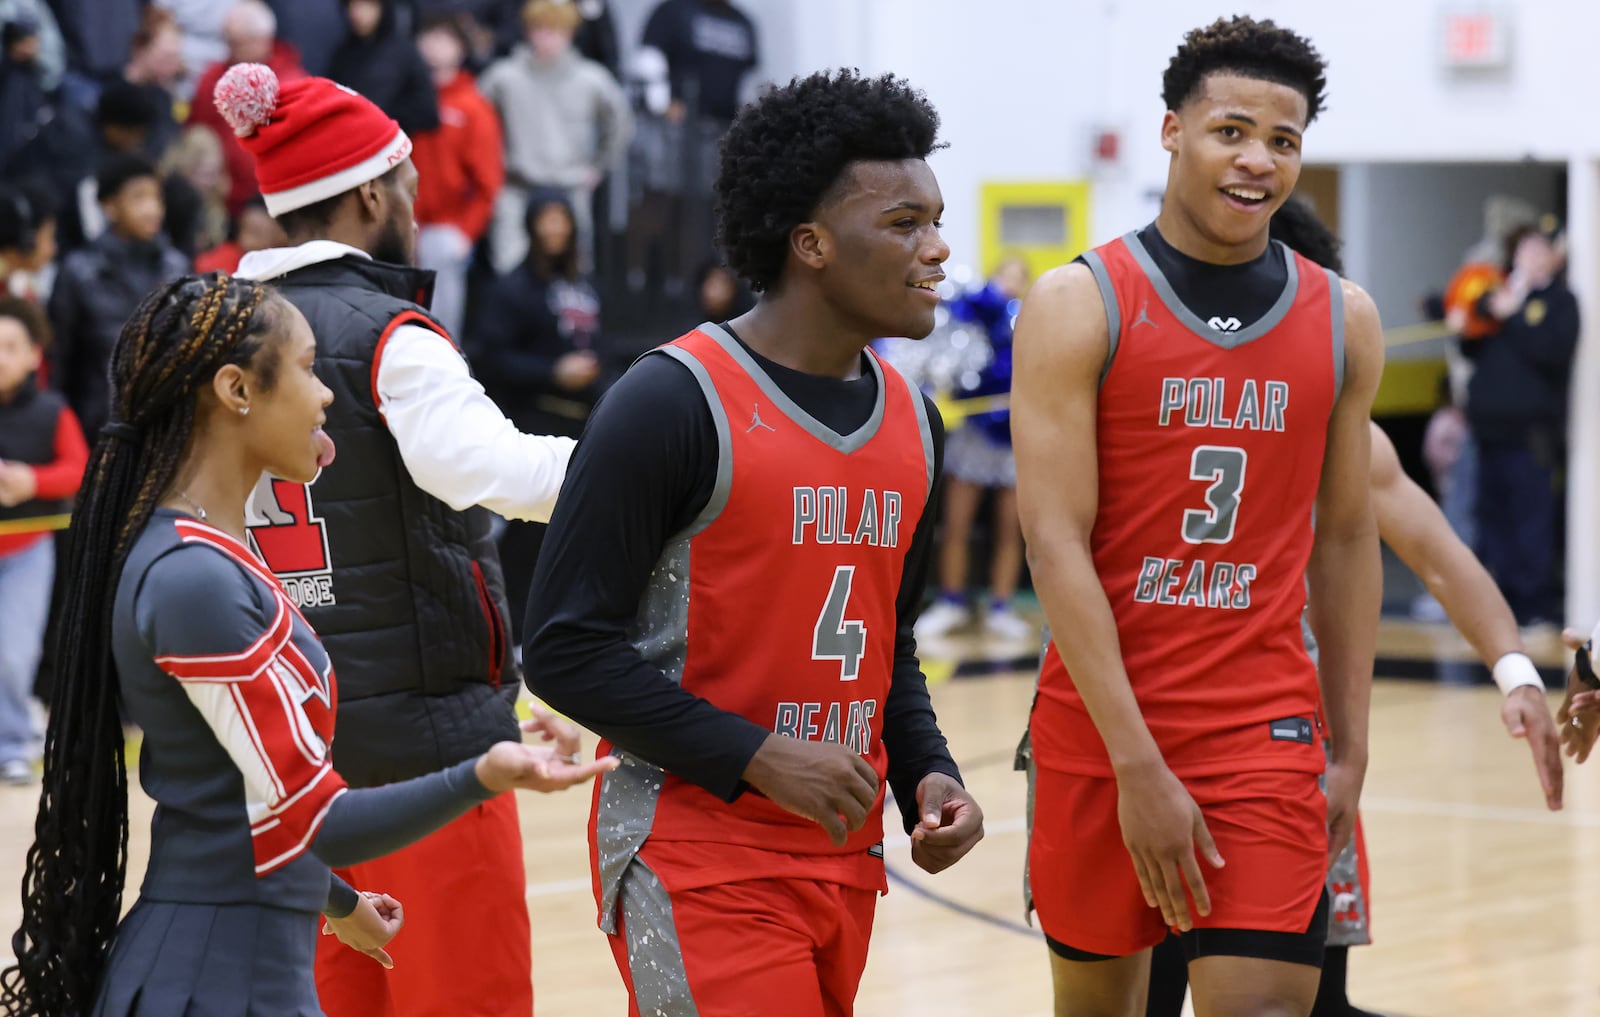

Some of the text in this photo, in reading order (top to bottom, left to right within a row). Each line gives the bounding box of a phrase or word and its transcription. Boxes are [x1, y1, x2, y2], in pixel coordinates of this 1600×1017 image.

[1158, 377, 1289, 432] POLAR
[792, 486, 902, 548] POLAR
[1181, 444, 1247, 544] 3
[1134, 556, 1257, 609] BEARS
[811, 565, 868, 682] 4
[774, 699, 877, 757] BEARS
